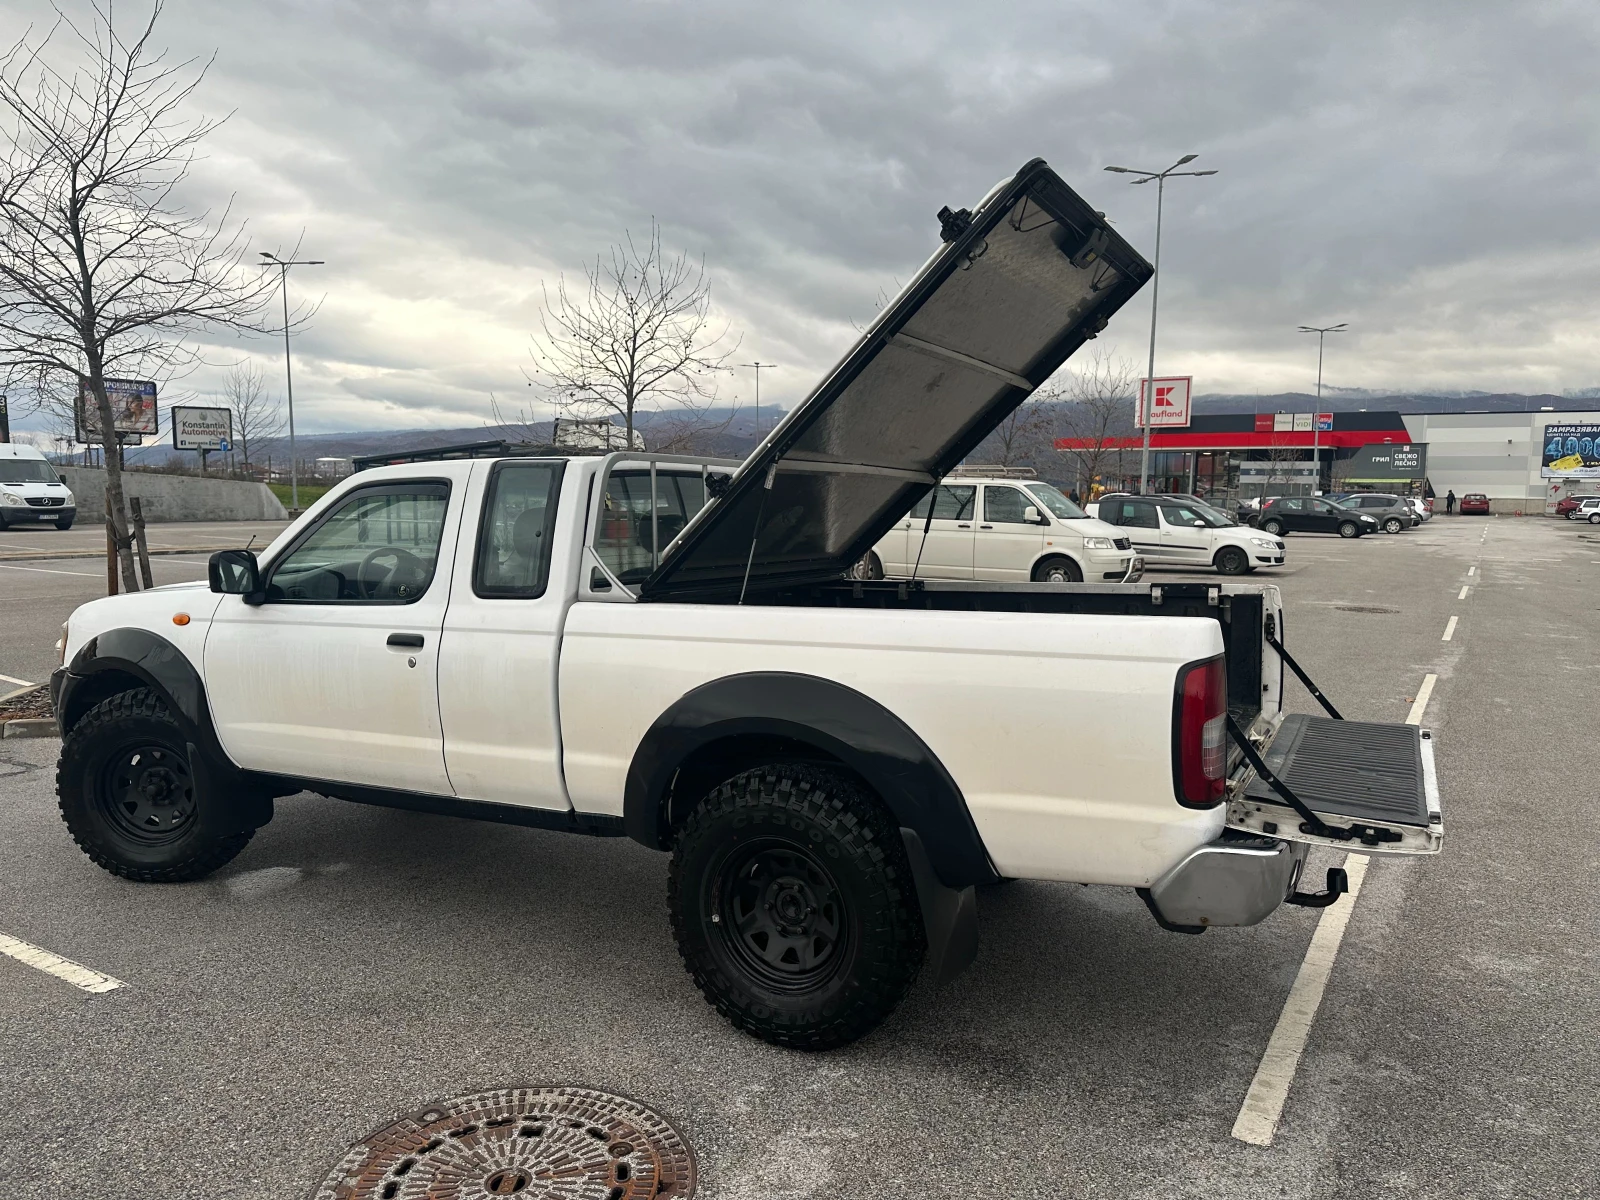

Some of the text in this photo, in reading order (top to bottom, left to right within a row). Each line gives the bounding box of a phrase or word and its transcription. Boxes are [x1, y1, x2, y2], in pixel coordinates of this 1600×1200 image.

[1148, 410, 1183, 418] aufland
[182, 421, 225, 429] Konstantin
[181, 428, 228, 436] Automotive
